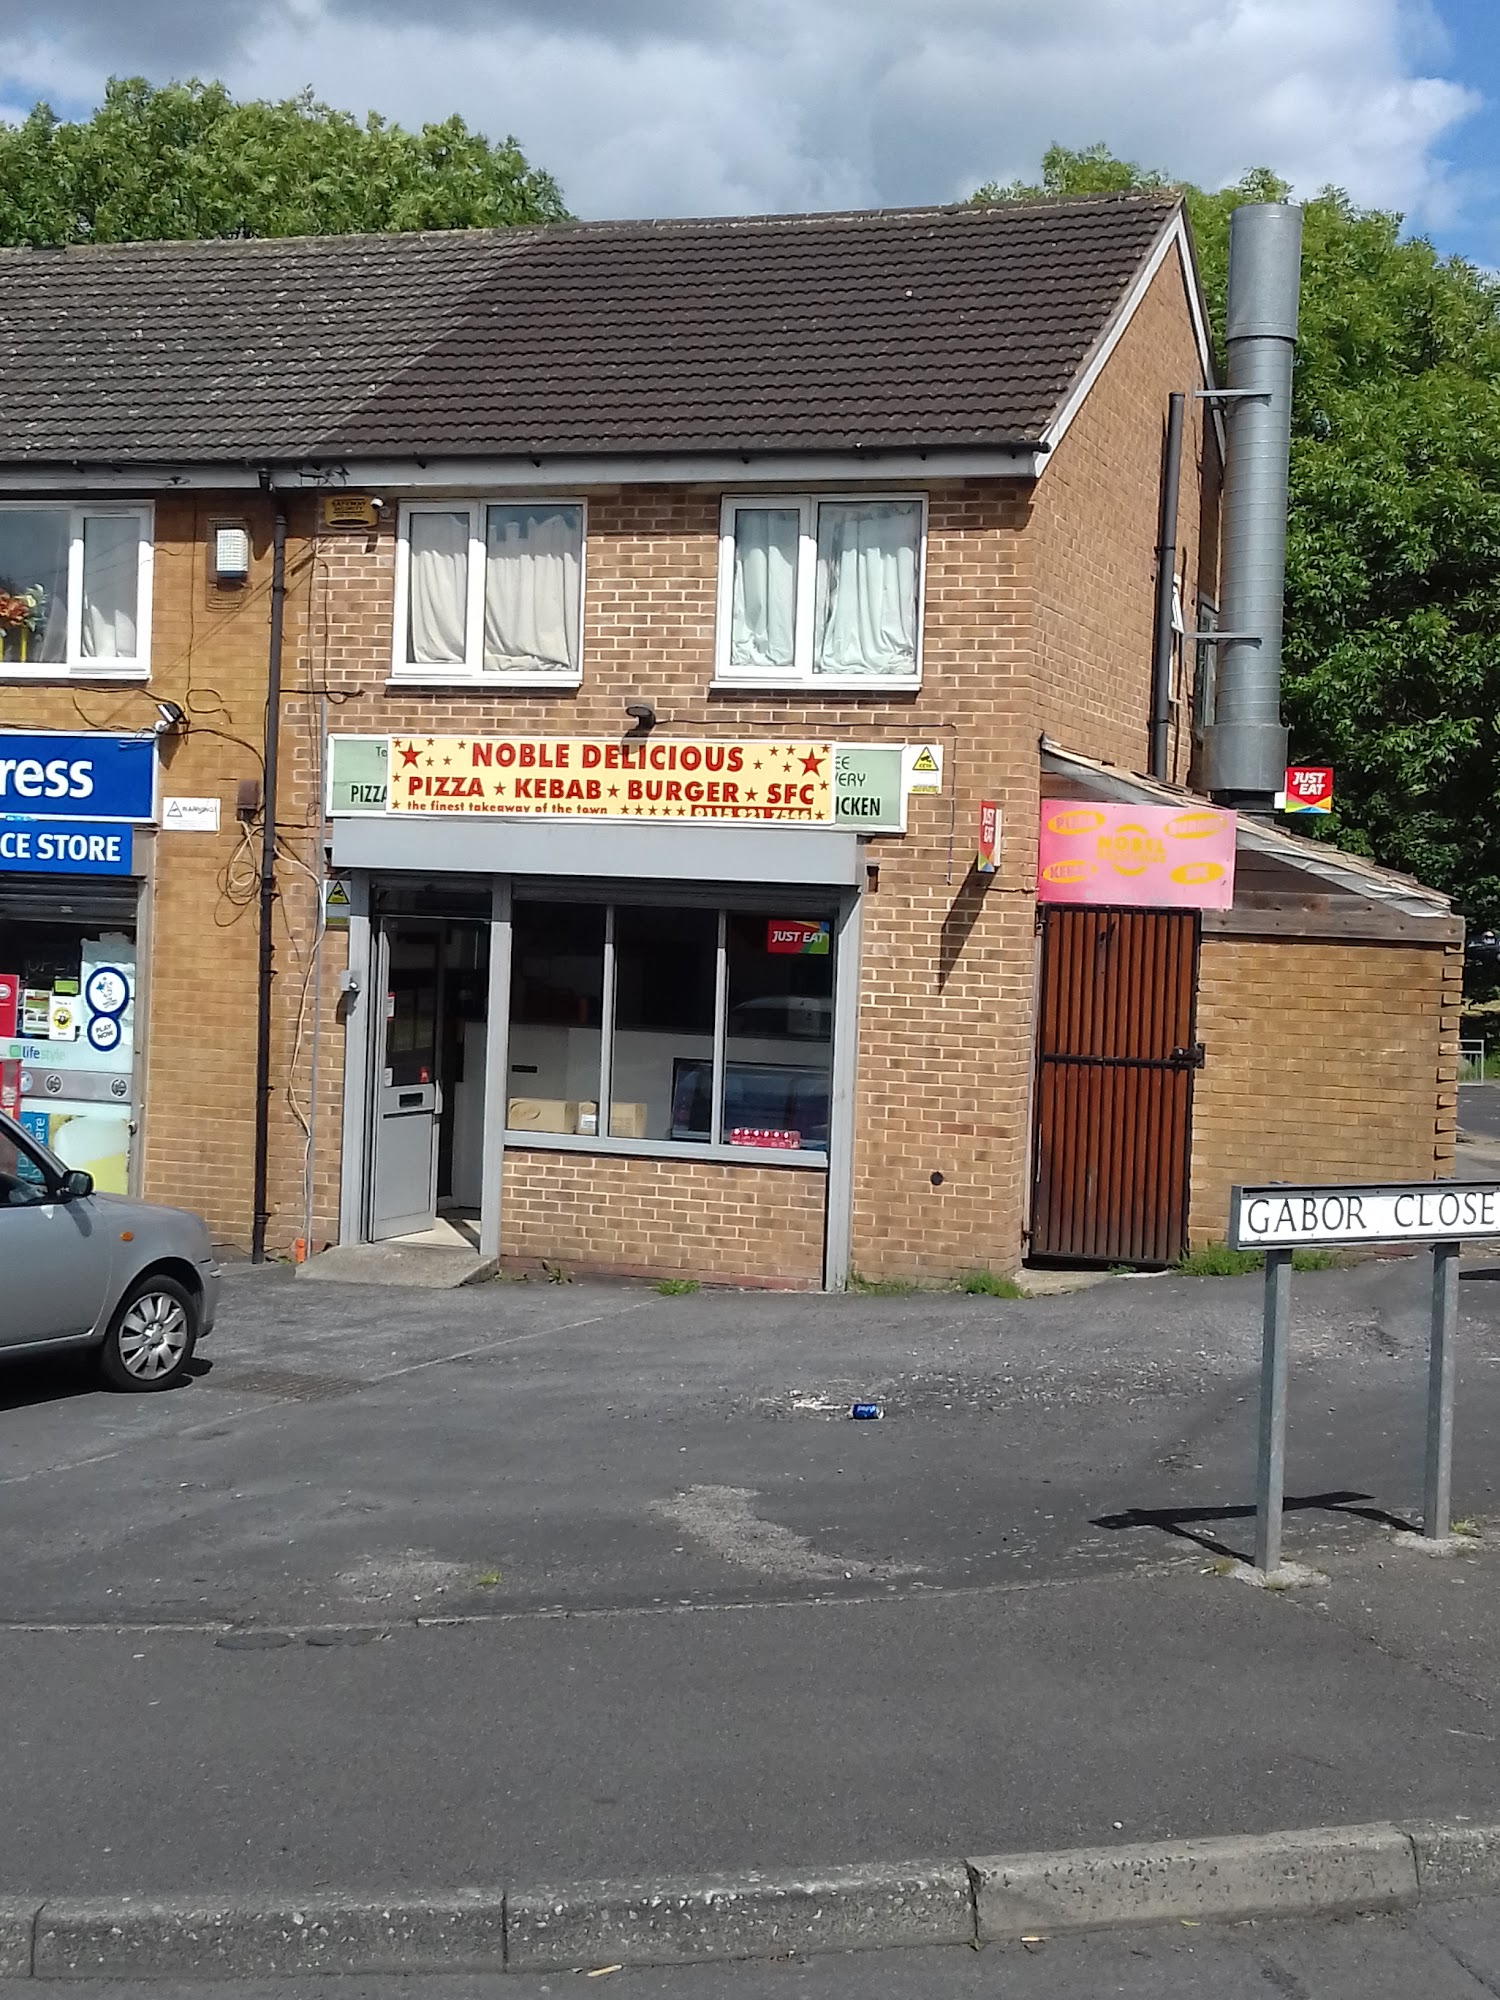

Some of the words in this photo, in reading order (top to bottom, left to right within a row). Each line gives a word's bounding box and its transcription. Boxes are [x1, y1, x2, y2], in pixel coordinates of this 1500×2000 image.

[471, 742, 570, 768] NOBLE
[582, 743, 744, 771] DELICIOUS
[0, 759, 94, 798] ress
[1292, 771, 1327, 785] JUST
[408, 776, 485, 798] PIZZA
[514, 778, 602, 800] KEBAB
[627, 780, 739, 802] BURGER
[766, 783, 815, 805] SFC
[1298, 783, 1326, 795] EAT
[407, 800, 427, 811] the
[430, 800, 465, 811] finest
[468, 802, 530, 814] takeaway
[535, 803, 548, 813] of
[551, 803, 573, 814] the
[576, 805, 608, 815] town
[694, 806, 734, 818] 0115
[835, 796, 881, 816] ICKEN
[0, 832, 31, 859] CE
[36, 833, 121, 862] STORE
[771, 930, 801, 943] JUST
[802, 931, 826, 943] EAT
[95, 1023, 112, 1033] PLAY
[97, 1030, 113, 1040] NOW
[1247, 1195, 1367, 1234] GABOR
[1394, 1191, 1495, 1227] CLOSE
